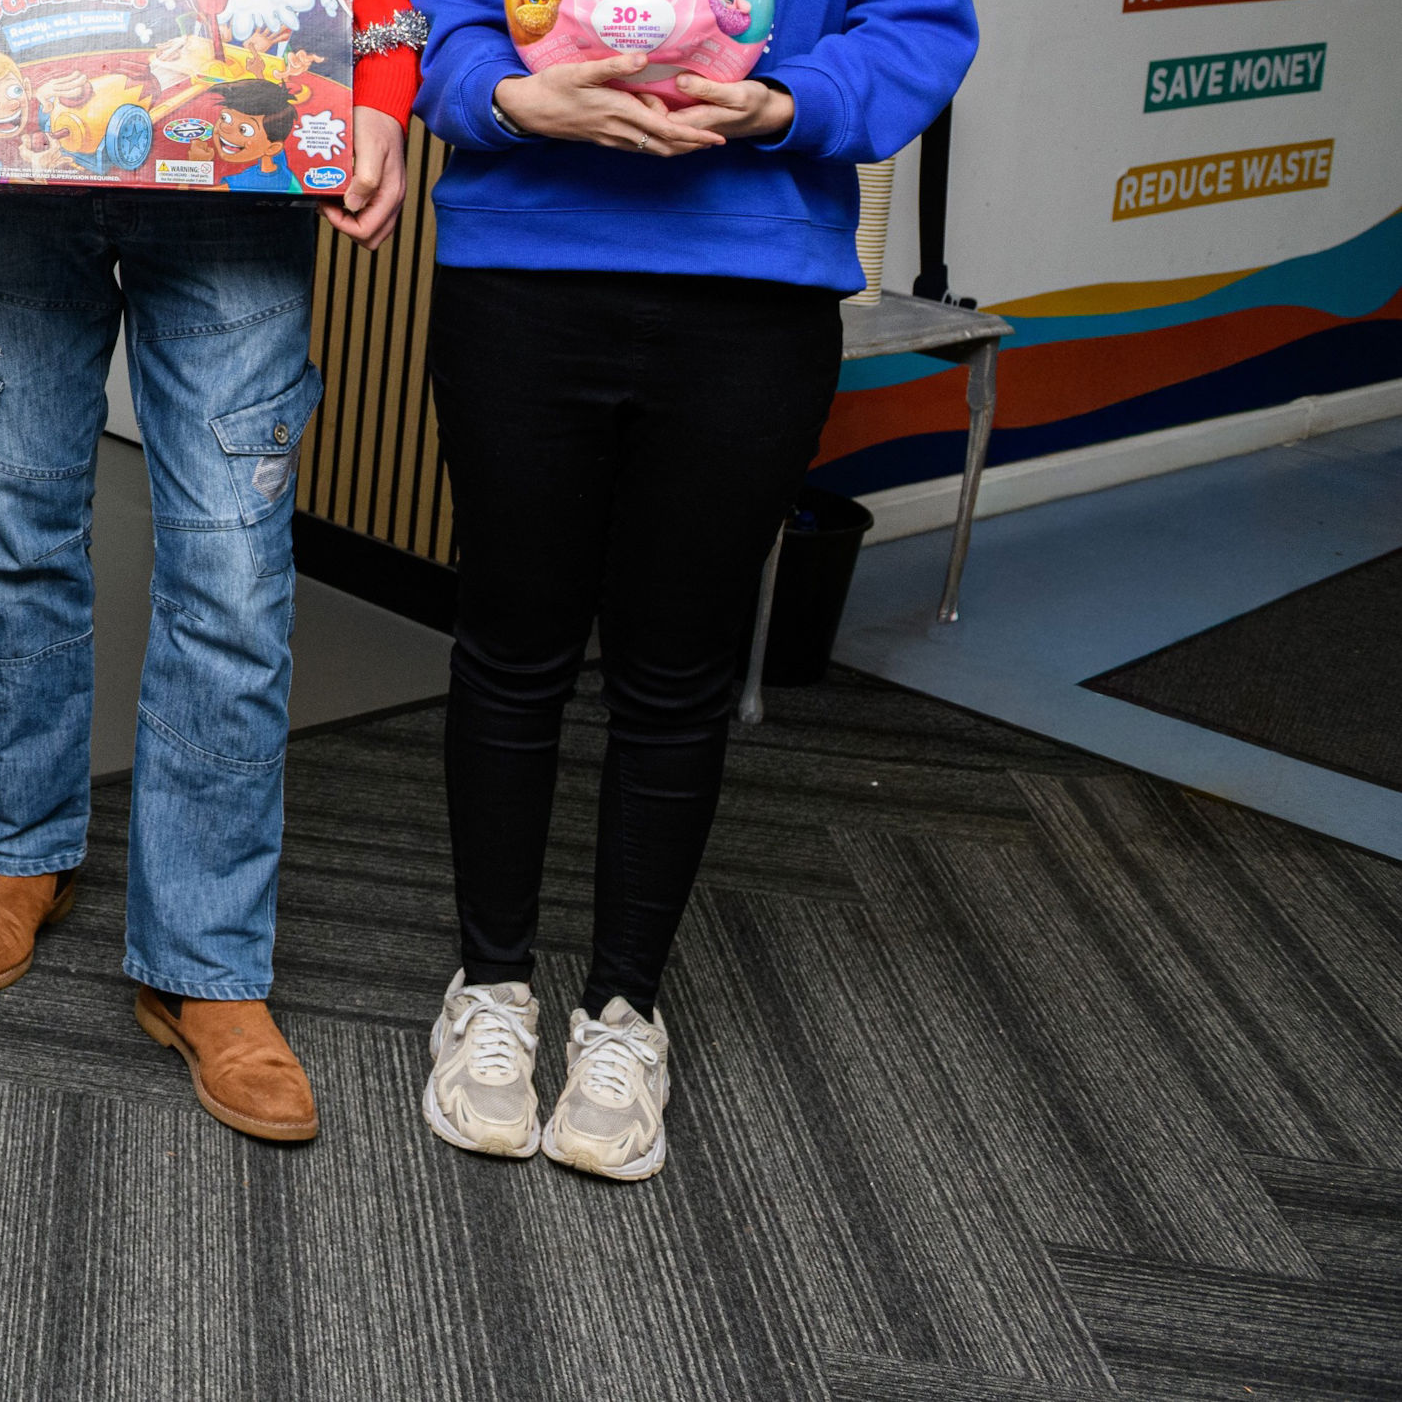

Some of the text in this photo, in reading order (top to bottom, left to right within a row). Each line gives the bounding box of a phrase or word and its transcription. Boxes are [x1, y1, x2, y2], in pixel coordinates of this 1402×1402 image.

[80, 13, 124, 23] launch!
[1150, 50, 1324, 103] SAVE MONEY
[310, 169, 342, 179] Hasbro
[1119, 148, 1331, 211] REDUCE WASTE
